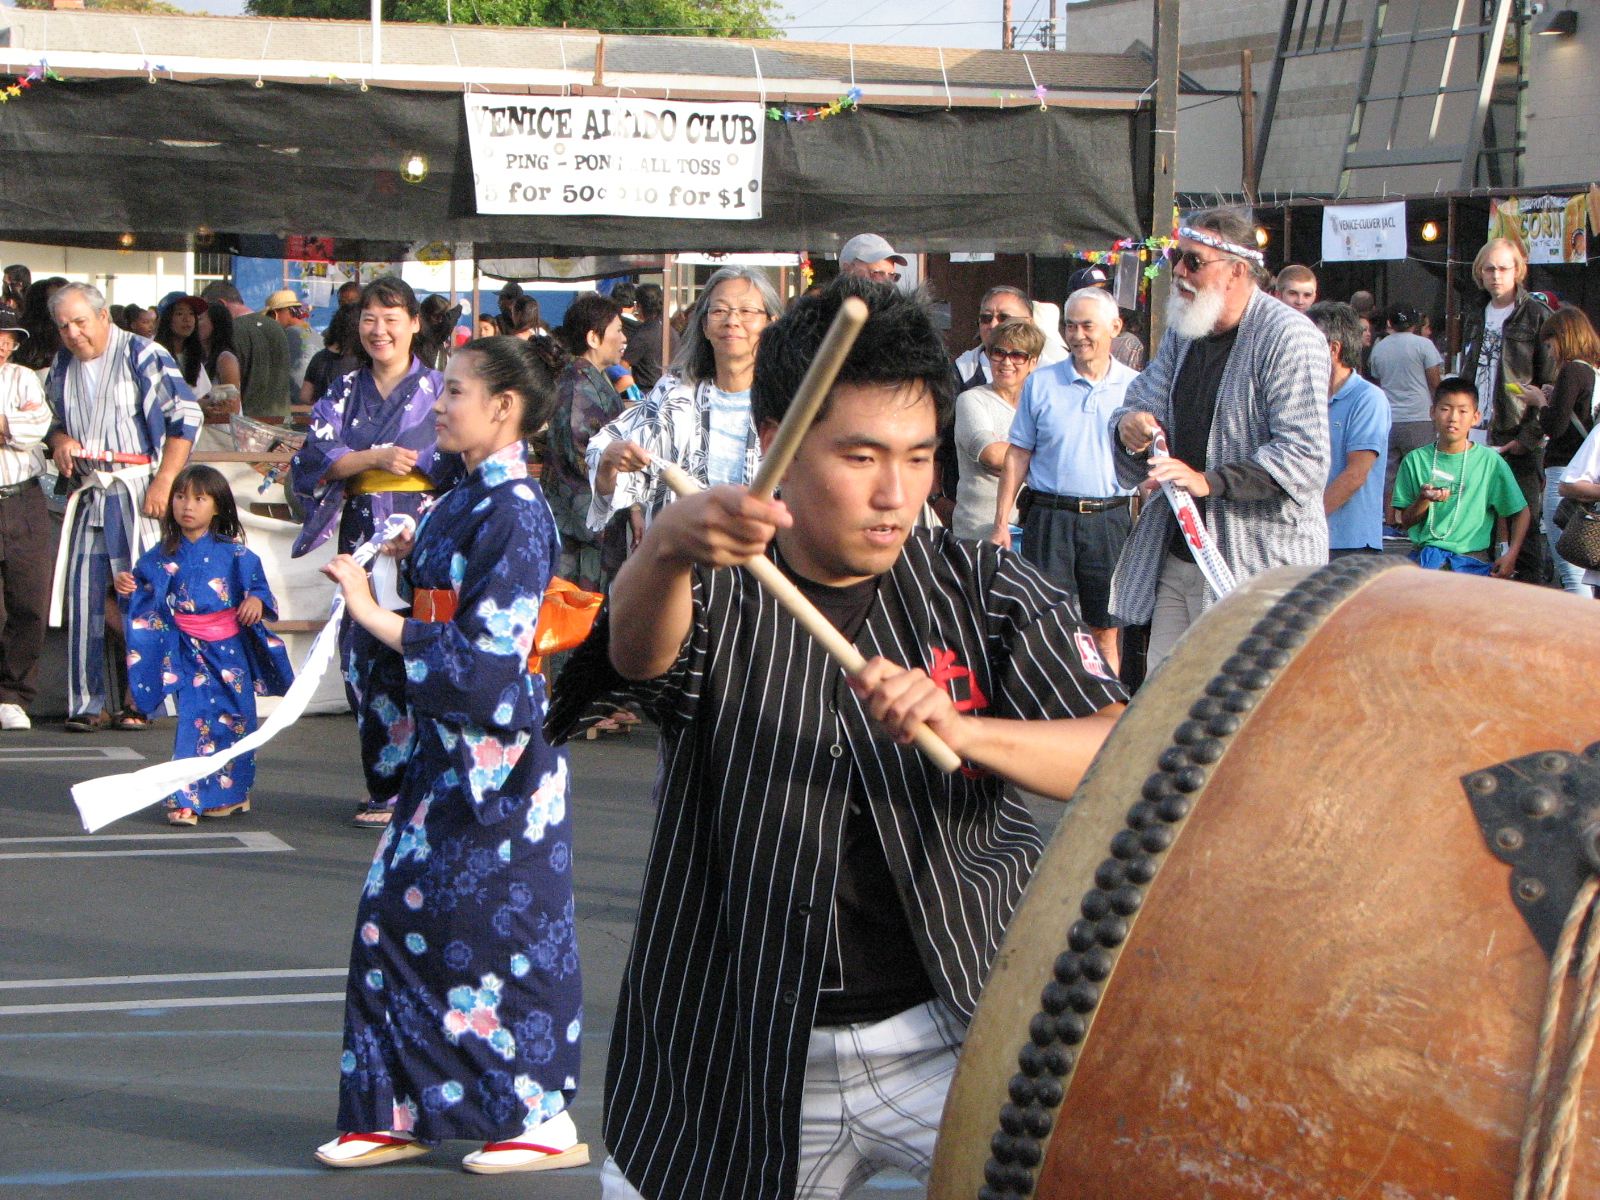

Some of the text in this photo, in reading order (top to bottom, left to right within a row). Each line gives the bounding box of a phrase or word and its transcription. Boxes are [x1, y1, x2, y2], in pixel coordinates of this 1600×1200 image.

[471, 105, 572, 138] VENICE
[686, 113, 757, 145] CLUB
[506, 154, 549, 171] PING
[629, 156, 671, 174] ALL
[677, 158, 721, 175] TOSS
[508, 181, 551, 203] for
[668, 186, 710, 207] for
[718, 188, 745, 208] $1
[1519, 211, 1561, 239] CORN
